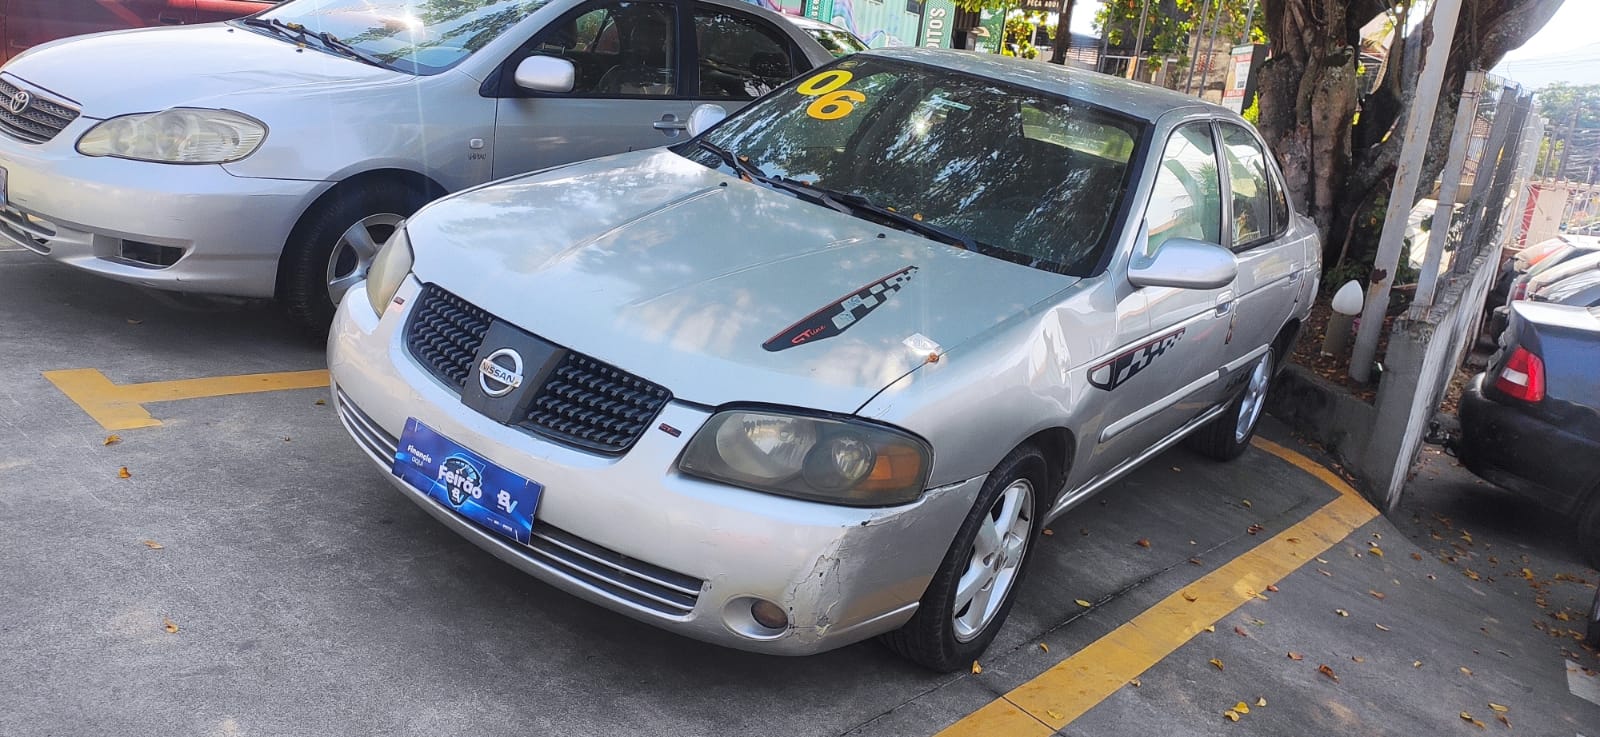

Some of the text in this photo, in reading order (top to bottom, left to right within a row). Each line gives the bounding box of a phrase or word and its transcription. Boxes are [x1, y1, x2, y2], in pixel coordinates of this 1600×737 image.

[483, 361, 517, 384] NISSAN
[407, 444, 431, 464] Financie
[438, 464, 483, 499] Feirão
